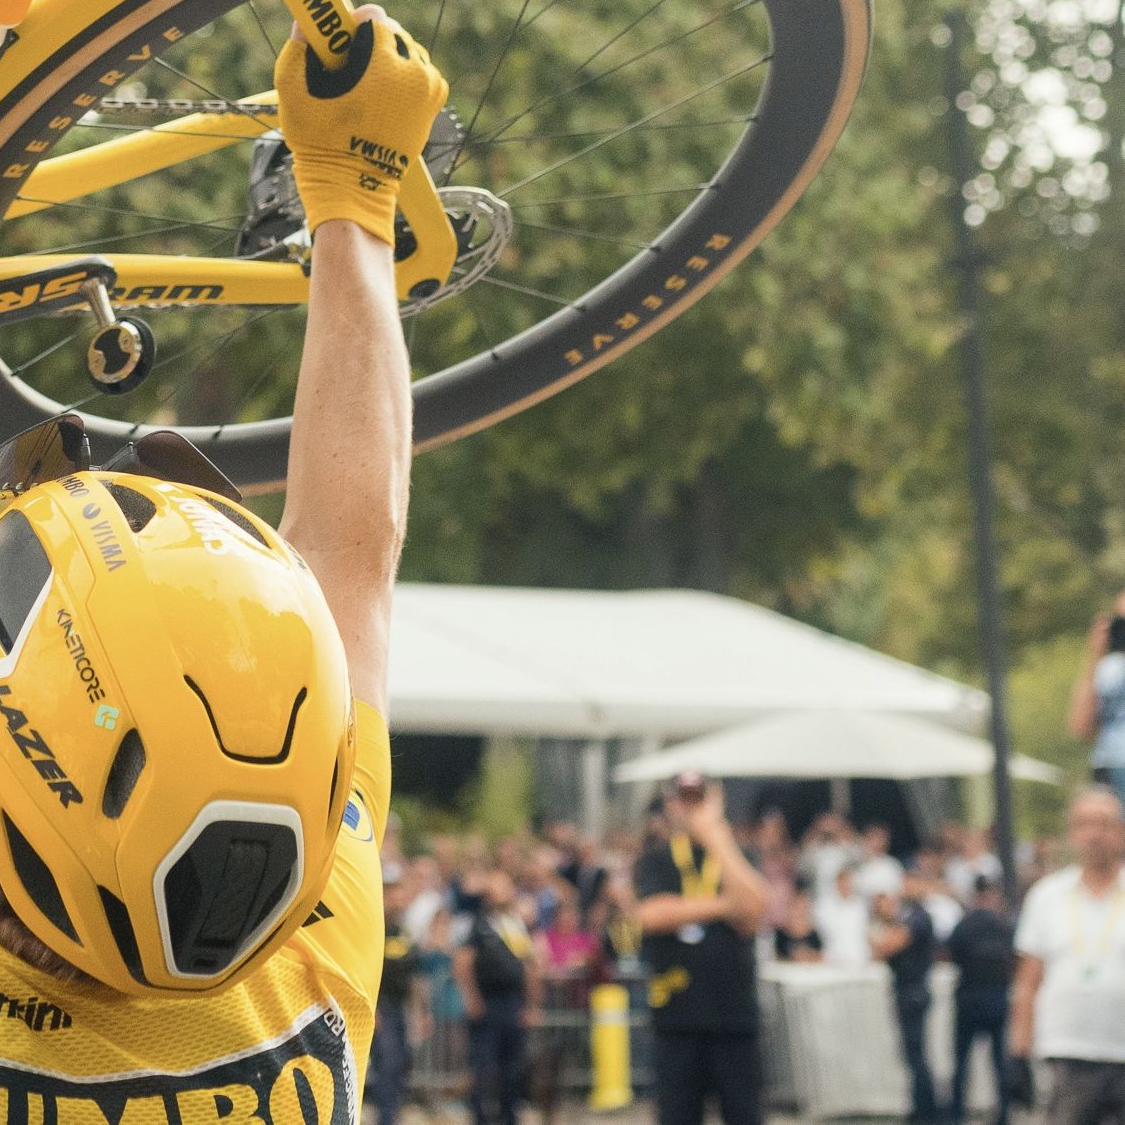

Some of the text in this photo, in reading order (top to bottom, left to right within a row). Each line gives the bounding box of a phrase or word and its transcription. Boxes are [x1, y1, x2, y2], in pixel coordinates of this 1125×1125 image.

[2, 26, 184, 179] RESERVE
[563, 233, 733, 366] RESERVE
[90, 520, 127, 572] VISMA
[57, 608, 106, 704] KINETICORE
